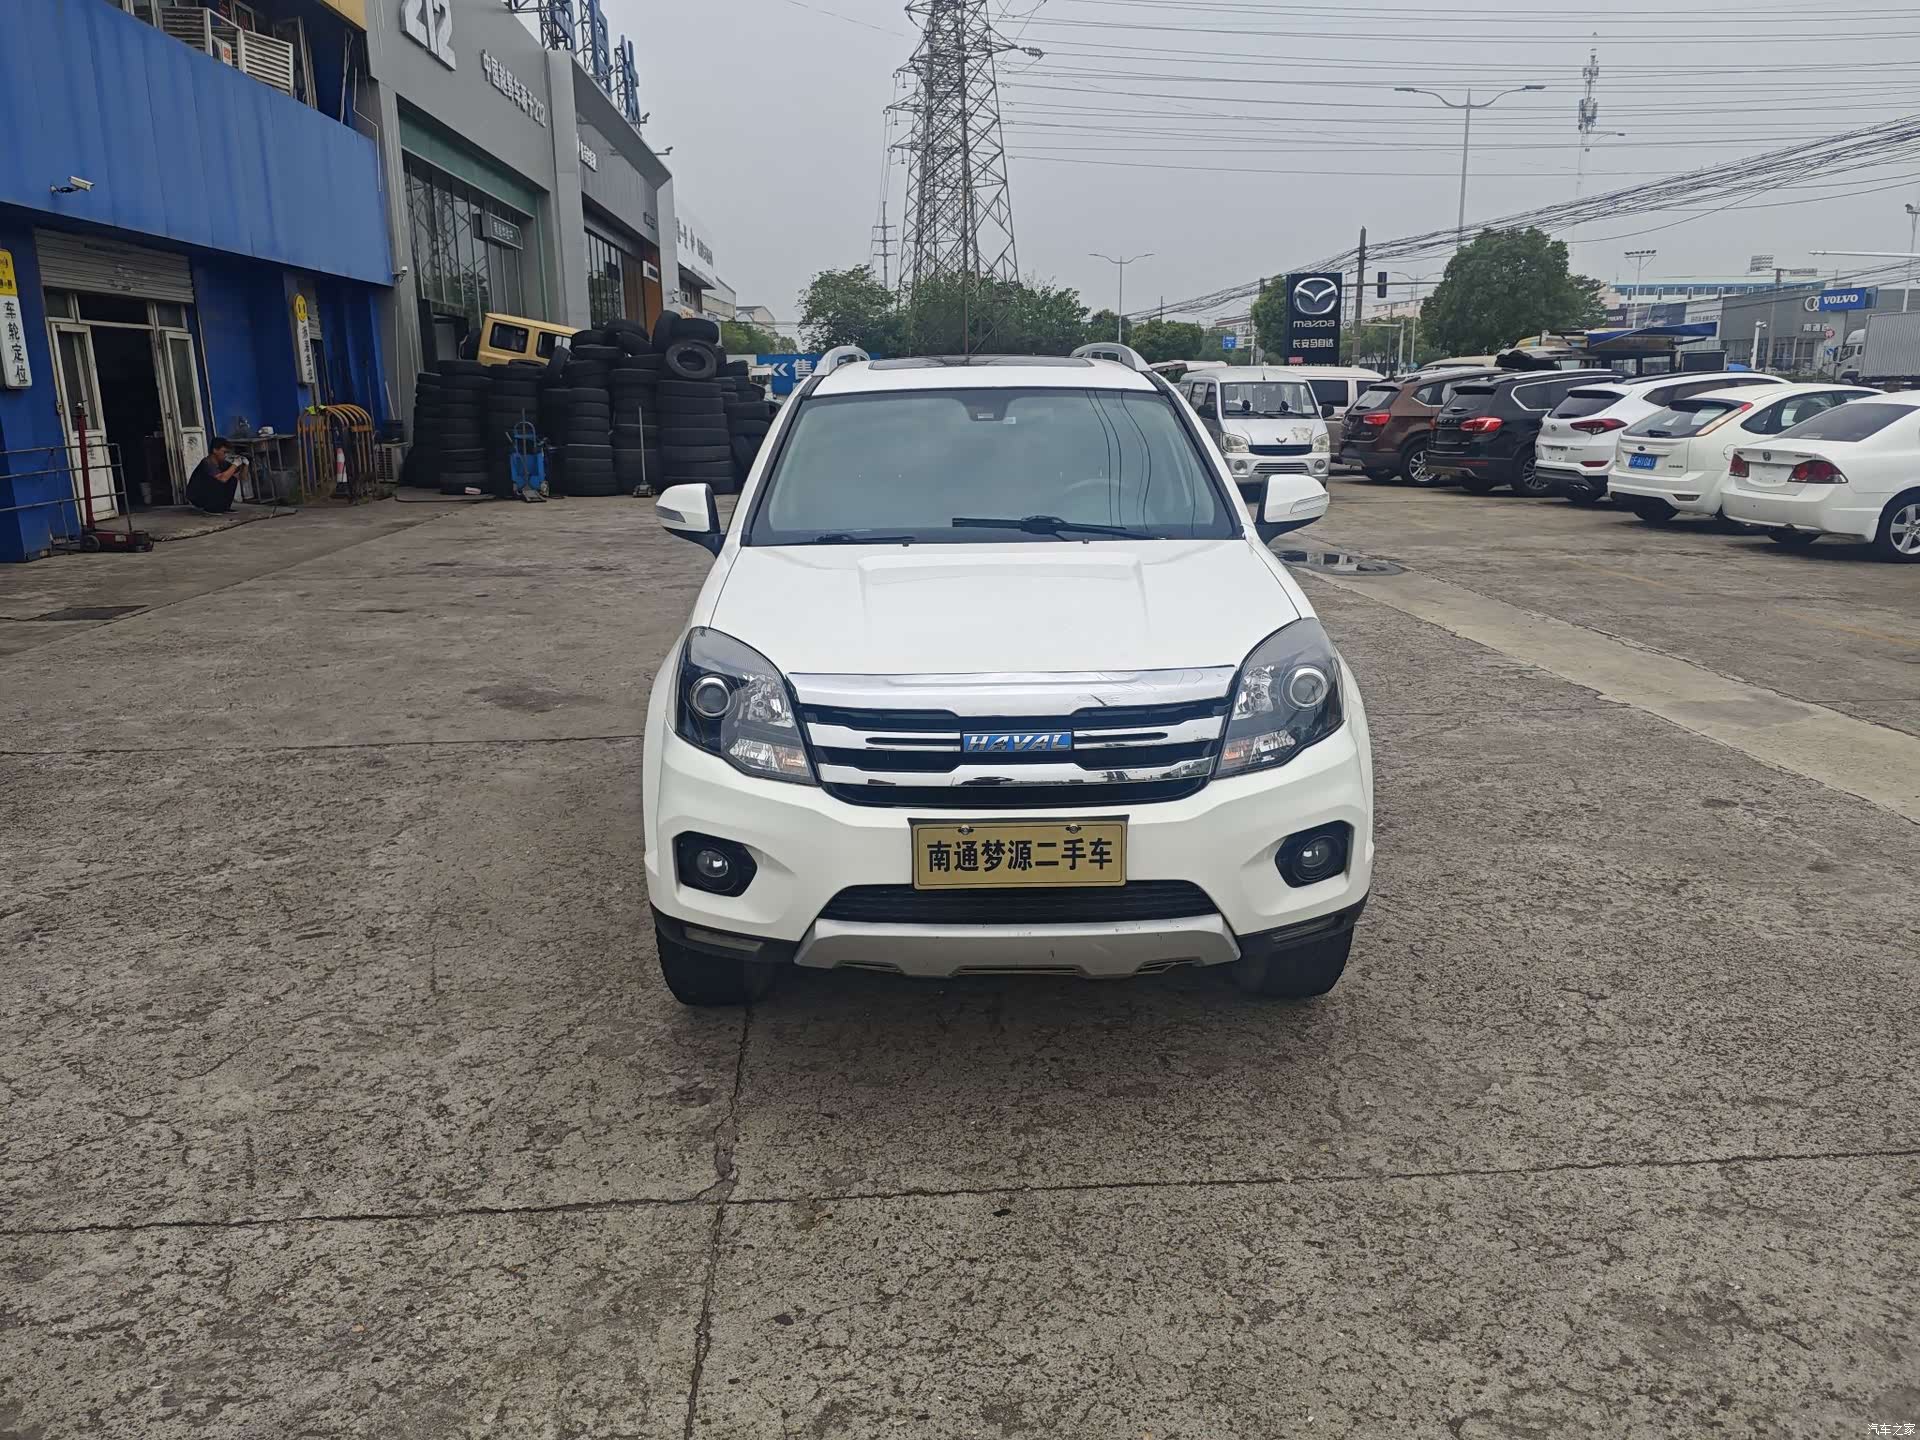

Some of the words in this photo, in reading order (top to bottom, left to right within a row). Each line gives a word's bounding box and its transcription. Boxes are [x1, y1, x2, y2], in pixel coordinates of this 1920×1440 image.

[1823, 294, 1859, 305] VOLVO
[1293, 320, 1335, 328] mazda
[3, 301, 28, 383] 车轮定位
[1293, 338, 1334, 349] 长安马自达
[967, 734, 1071, 751] HAVAL
[927, 838, 1113, 872] 南通梦源二手车
